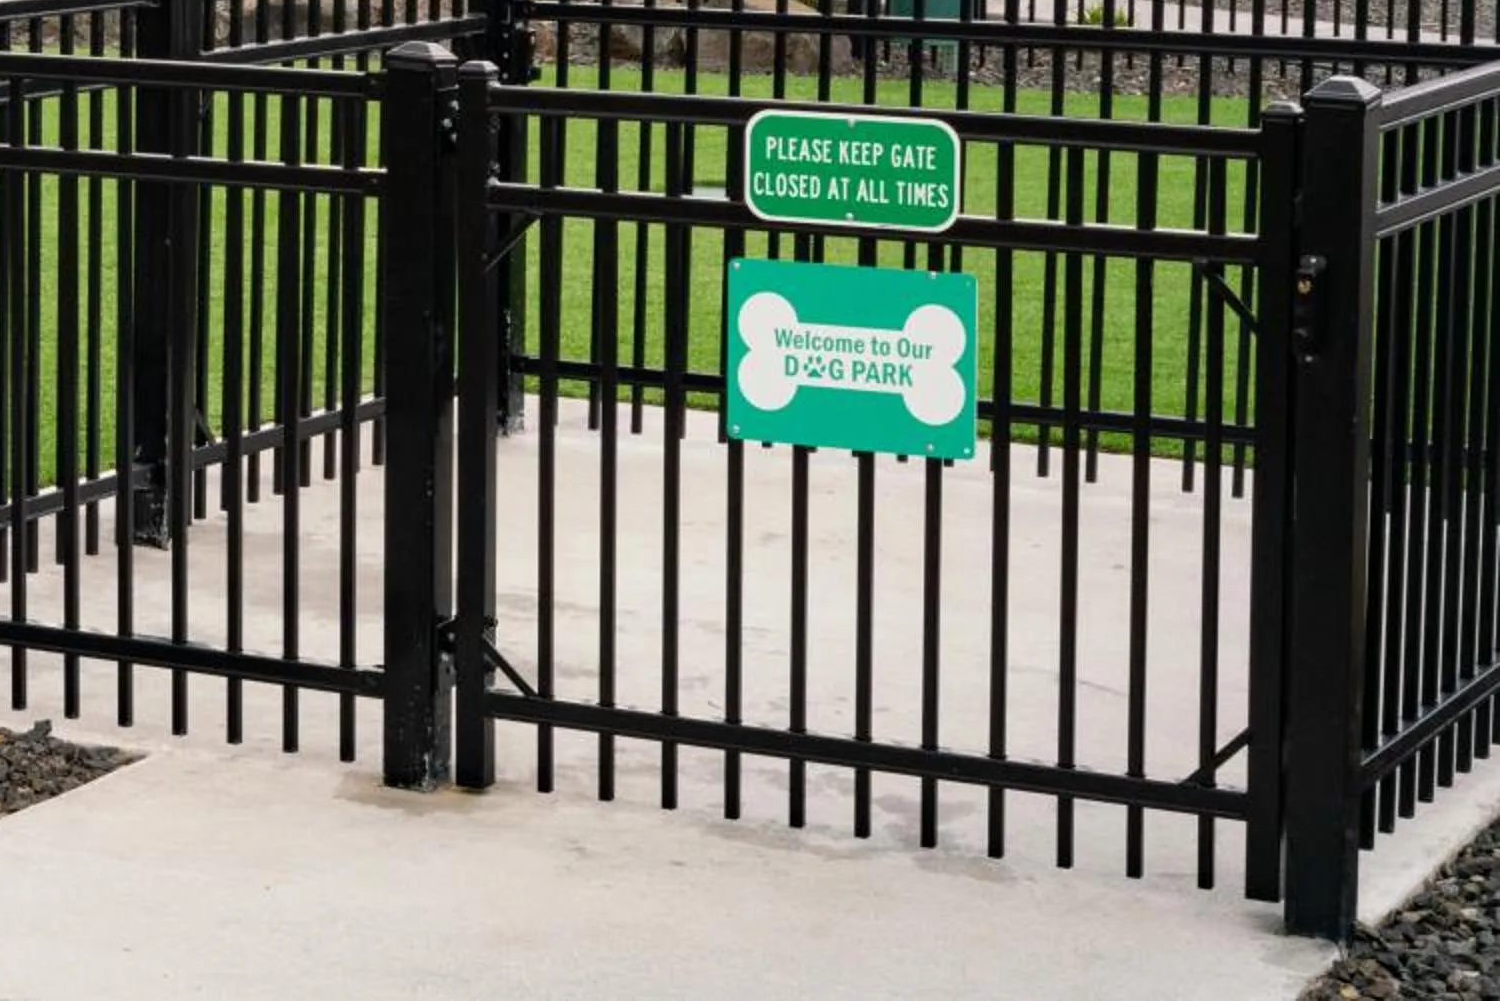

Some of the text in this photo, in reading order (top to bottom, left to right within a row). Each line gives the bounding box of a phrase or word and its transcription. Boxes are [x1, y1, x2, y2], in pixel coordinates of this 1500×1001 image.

[765, 136, 937, 171] PLEASE KEEP GATE
[753, 172, 949, 208] CLOSED AT ALL TIMES
[773, 327, 933, 360] Welcome to Our
[851, 359, 914, 387] PARK
